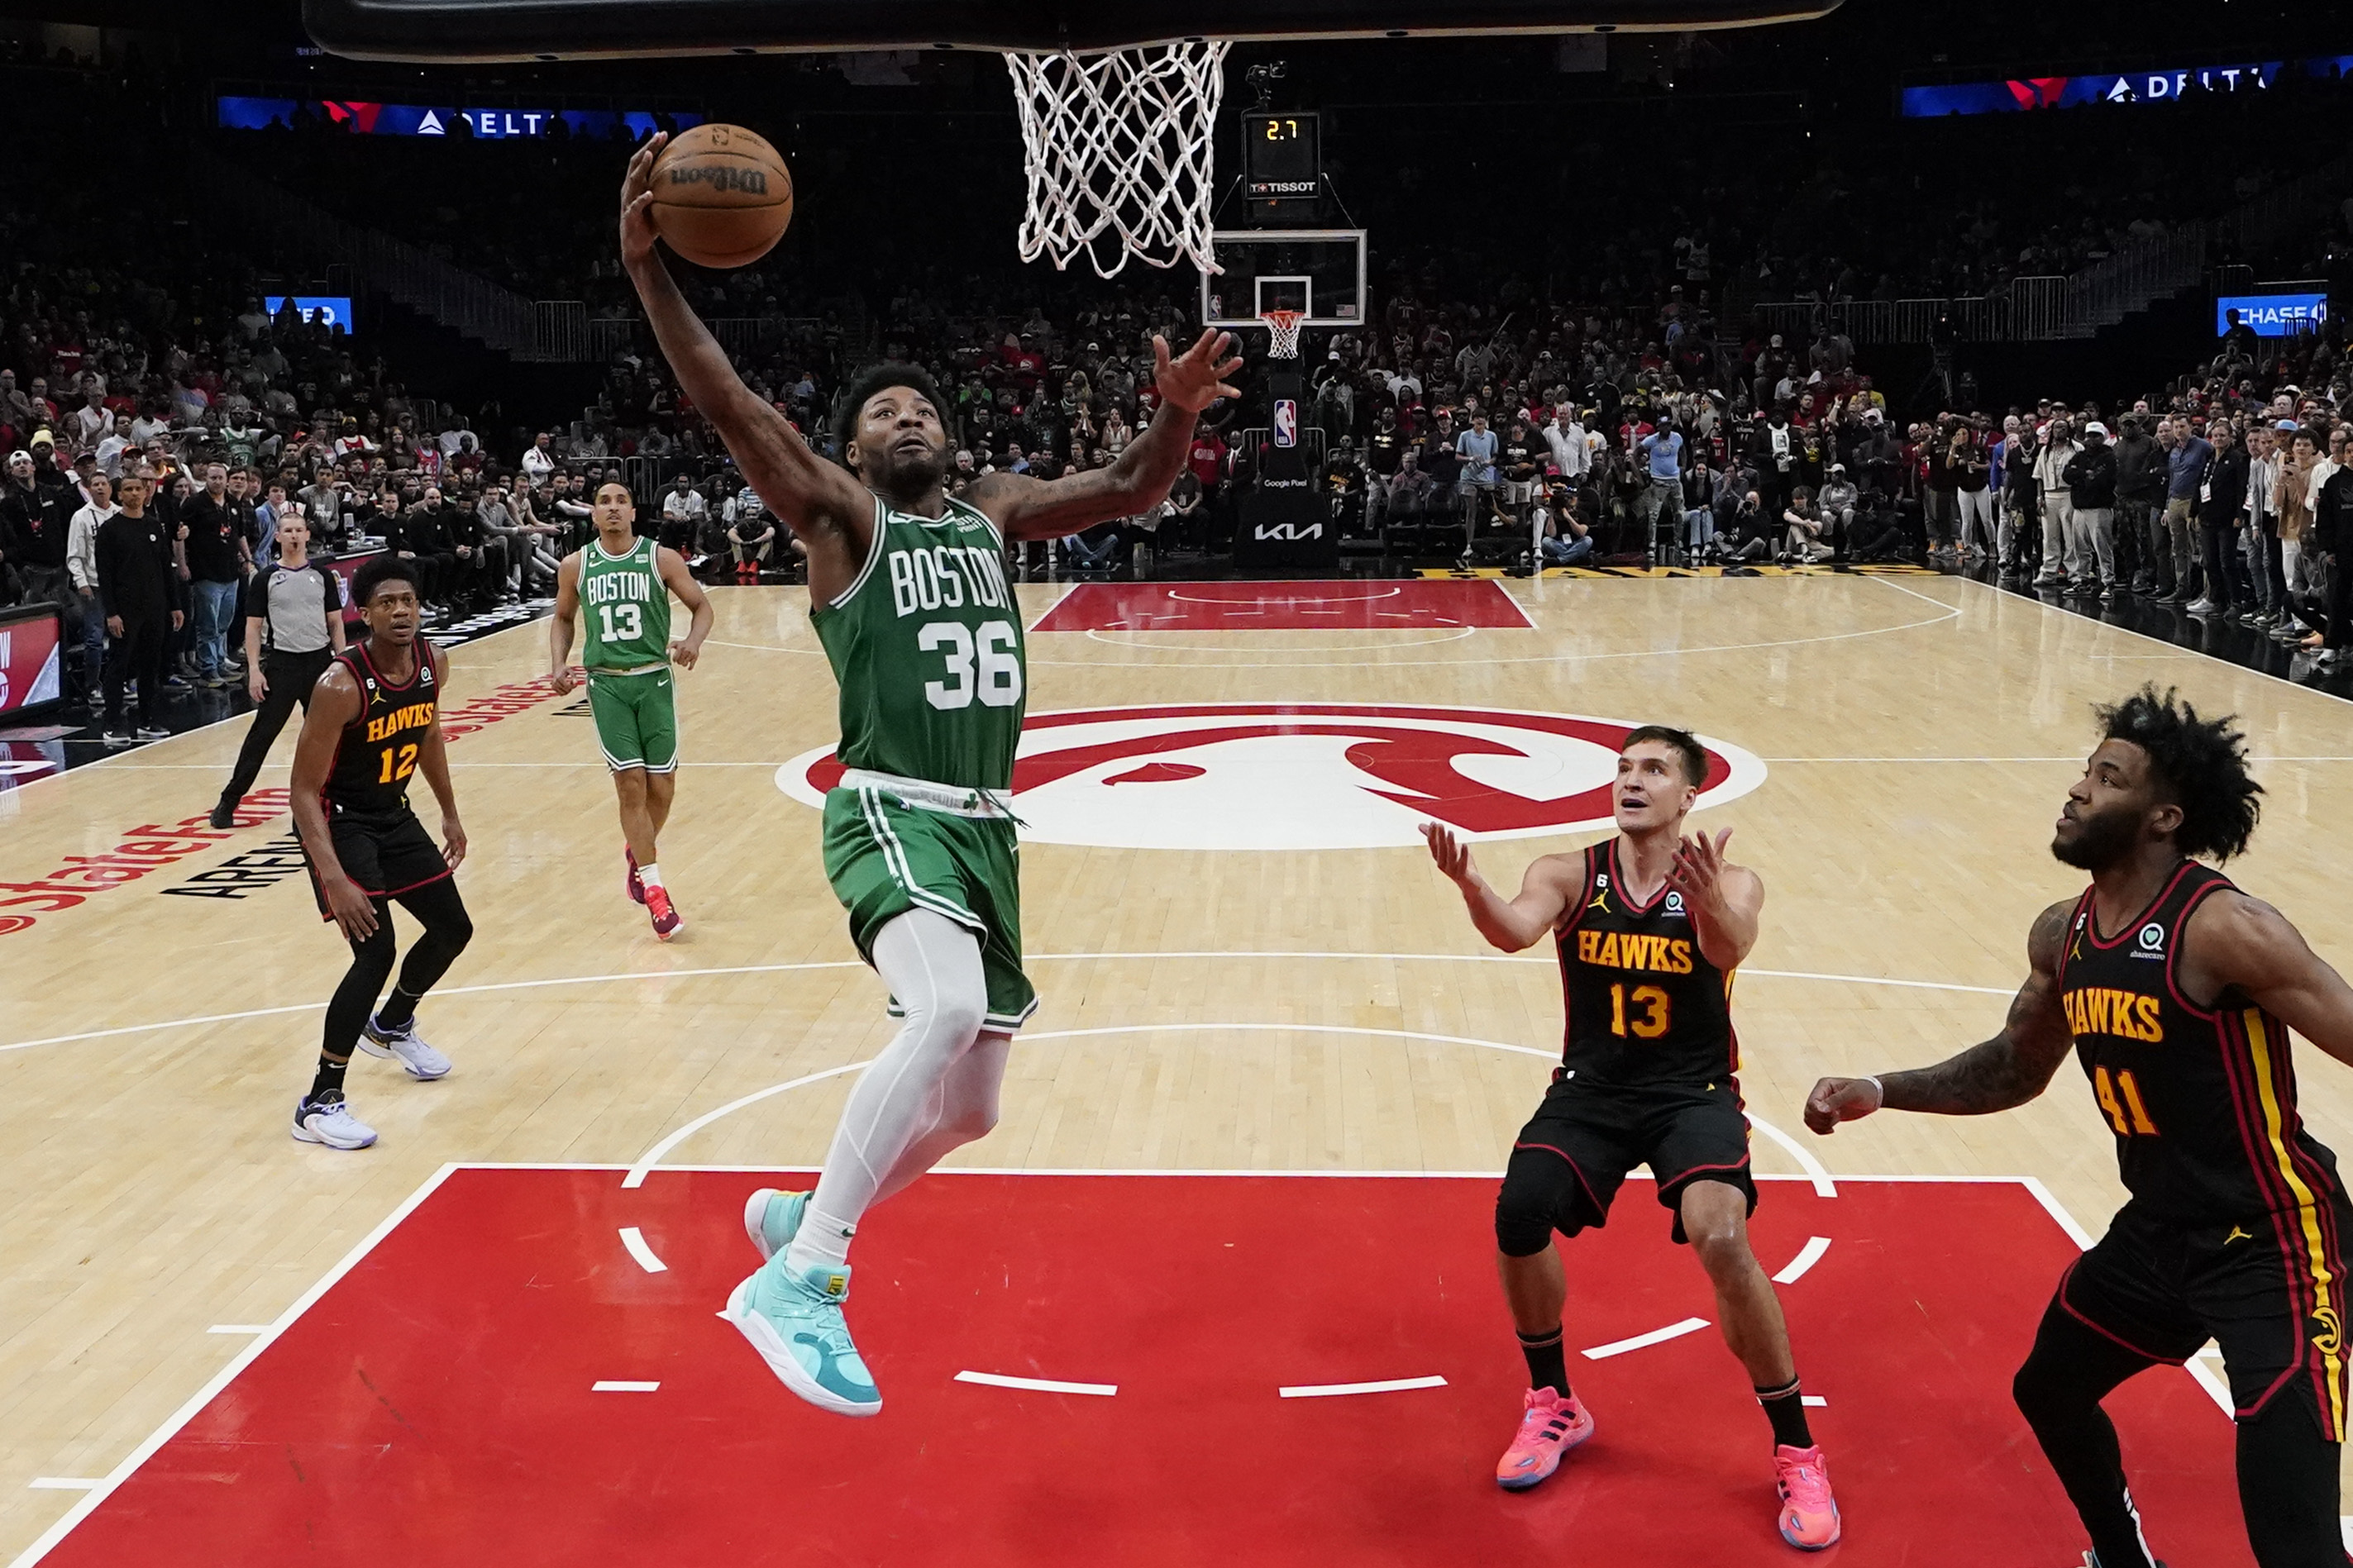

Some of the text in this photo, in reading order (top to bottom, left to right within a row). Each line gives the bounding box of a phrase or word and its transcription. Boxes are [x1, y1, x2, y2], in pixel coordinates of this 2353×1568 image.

[454, 112, 561, 135] ELT
[1267, 121, 1296, 140] 2.7
[671, 167, 767, 195] Wilson
[1268, 182, 1315, 192] TISSOT
[2236, 307, 2308, 325] CHASE
[1264, 479, 1290, 489] Google
[587, 572, 650, 607] BOSTON
[889, 545, 1013, 618] BOSTON
[599, 603, 643, 643] 13
[366, 678, 376, 689] 6
[918, 620, 1021, 710] 36
[366, 703, 435, 743] HAWKS
[379, 743, 418, 784] 12
[160, 832, 307, 899] AREN
[1596, 874, 1608, 888] 6
[1578, 930, 1693, 975] HAWKS
[1611, 983, 1672, 1039] 13
[2064, 988, 2164, 1042] HAWKS
[2095, 1065, 2161, 1137] 41
